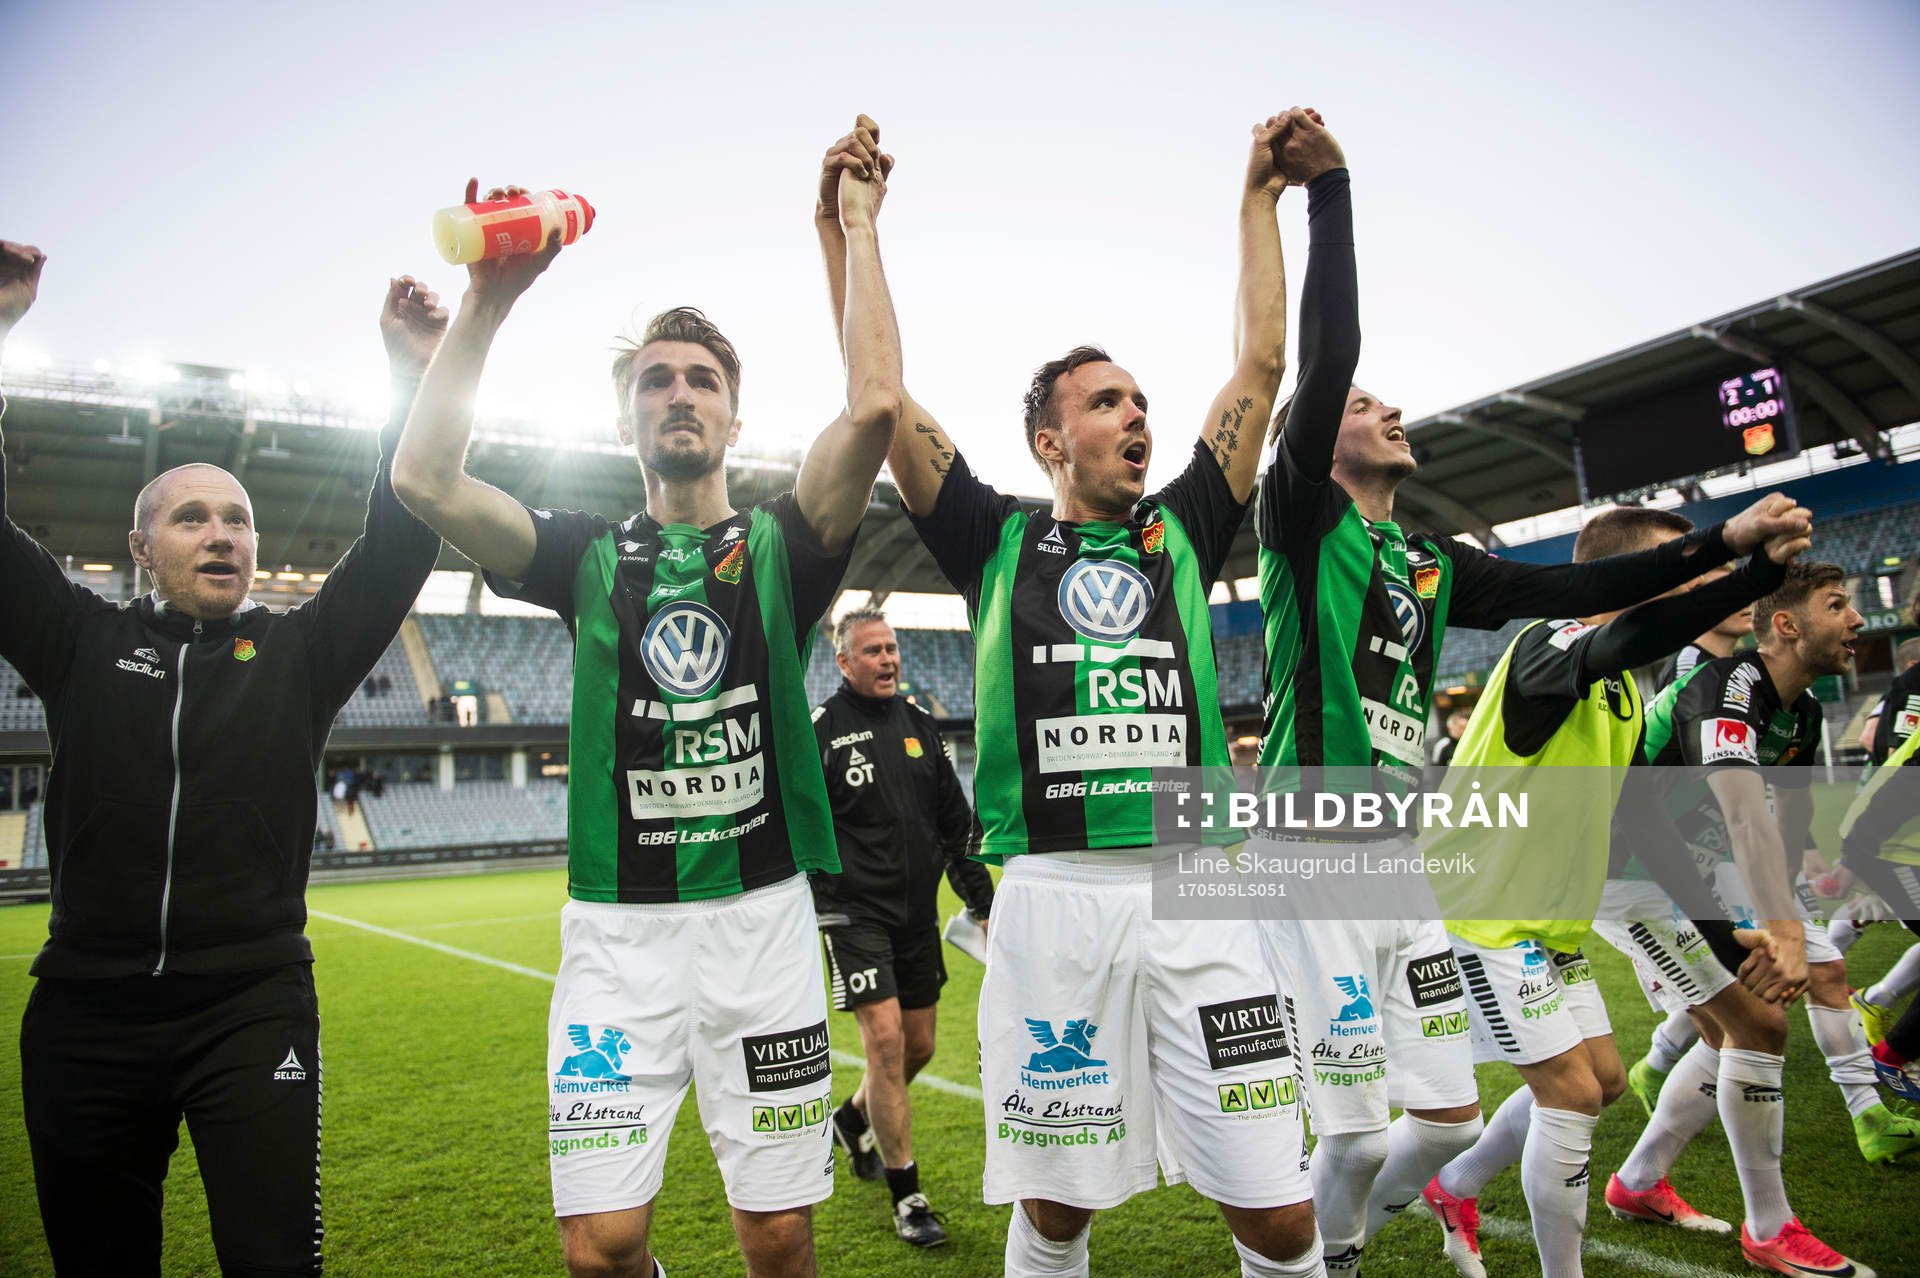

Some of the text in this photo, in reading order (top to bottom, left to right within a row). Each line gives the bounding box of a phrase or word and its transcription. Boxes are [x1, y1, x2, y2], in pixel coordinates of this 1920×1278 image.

[1729, 399, 1779, 427] 00:00
[1037, 542, 1067, 556] SELECT
[133, 648, 160, 663] SELECT
[1089, 669, 1184, 708] RSM
[675, 712, 761, 764] RSM
[1044, 723, 1182, 749] NORDIA
[1363, 707, 1424, 746] NORDI
[831, 730, 874, 750] stadium
[1047, 754, 1072, 763] SWEDEN
[1076, 752, 1104, 761] NORWAY
[1109, 751, 1138, 759] DENMARK
[1703, 750, 1744, 763] SVENSKA
[635, 765, 761, 797] NORDIA
[845, 763, 875, 787] OT
[1045, 779, 1191, 799] GBG Lackcenter
[638, 812, 769, 845] GBG Lackcenter
[1675, 930, 1697, 948] Åke
[849, 968, 878, 994] OT
[1517, 979, 1542, 999] Åke
[1211, 1003, 1283, 1033] VIRTUA
[752, 1030, 828, 1062] VIRTUAL
[1311, 1038, 1386, 1059] Åke Ekstr
[273, 1071, 307, 1080] SELECT
[756, 1058, 828, 1084] manufacturing
[1021, 1071, 1109, 1090] Hemverket
[553, 1079, 631, 1094] Hemverket
[566, 1102, 645, 1121] Ekstrand
[1002, 1089, 1124, 1119] Åke Ekstrand
[550, 1127, 649, 1156] ggnads AB
[997, 1121, 1127, 1148] Byggnads AB
